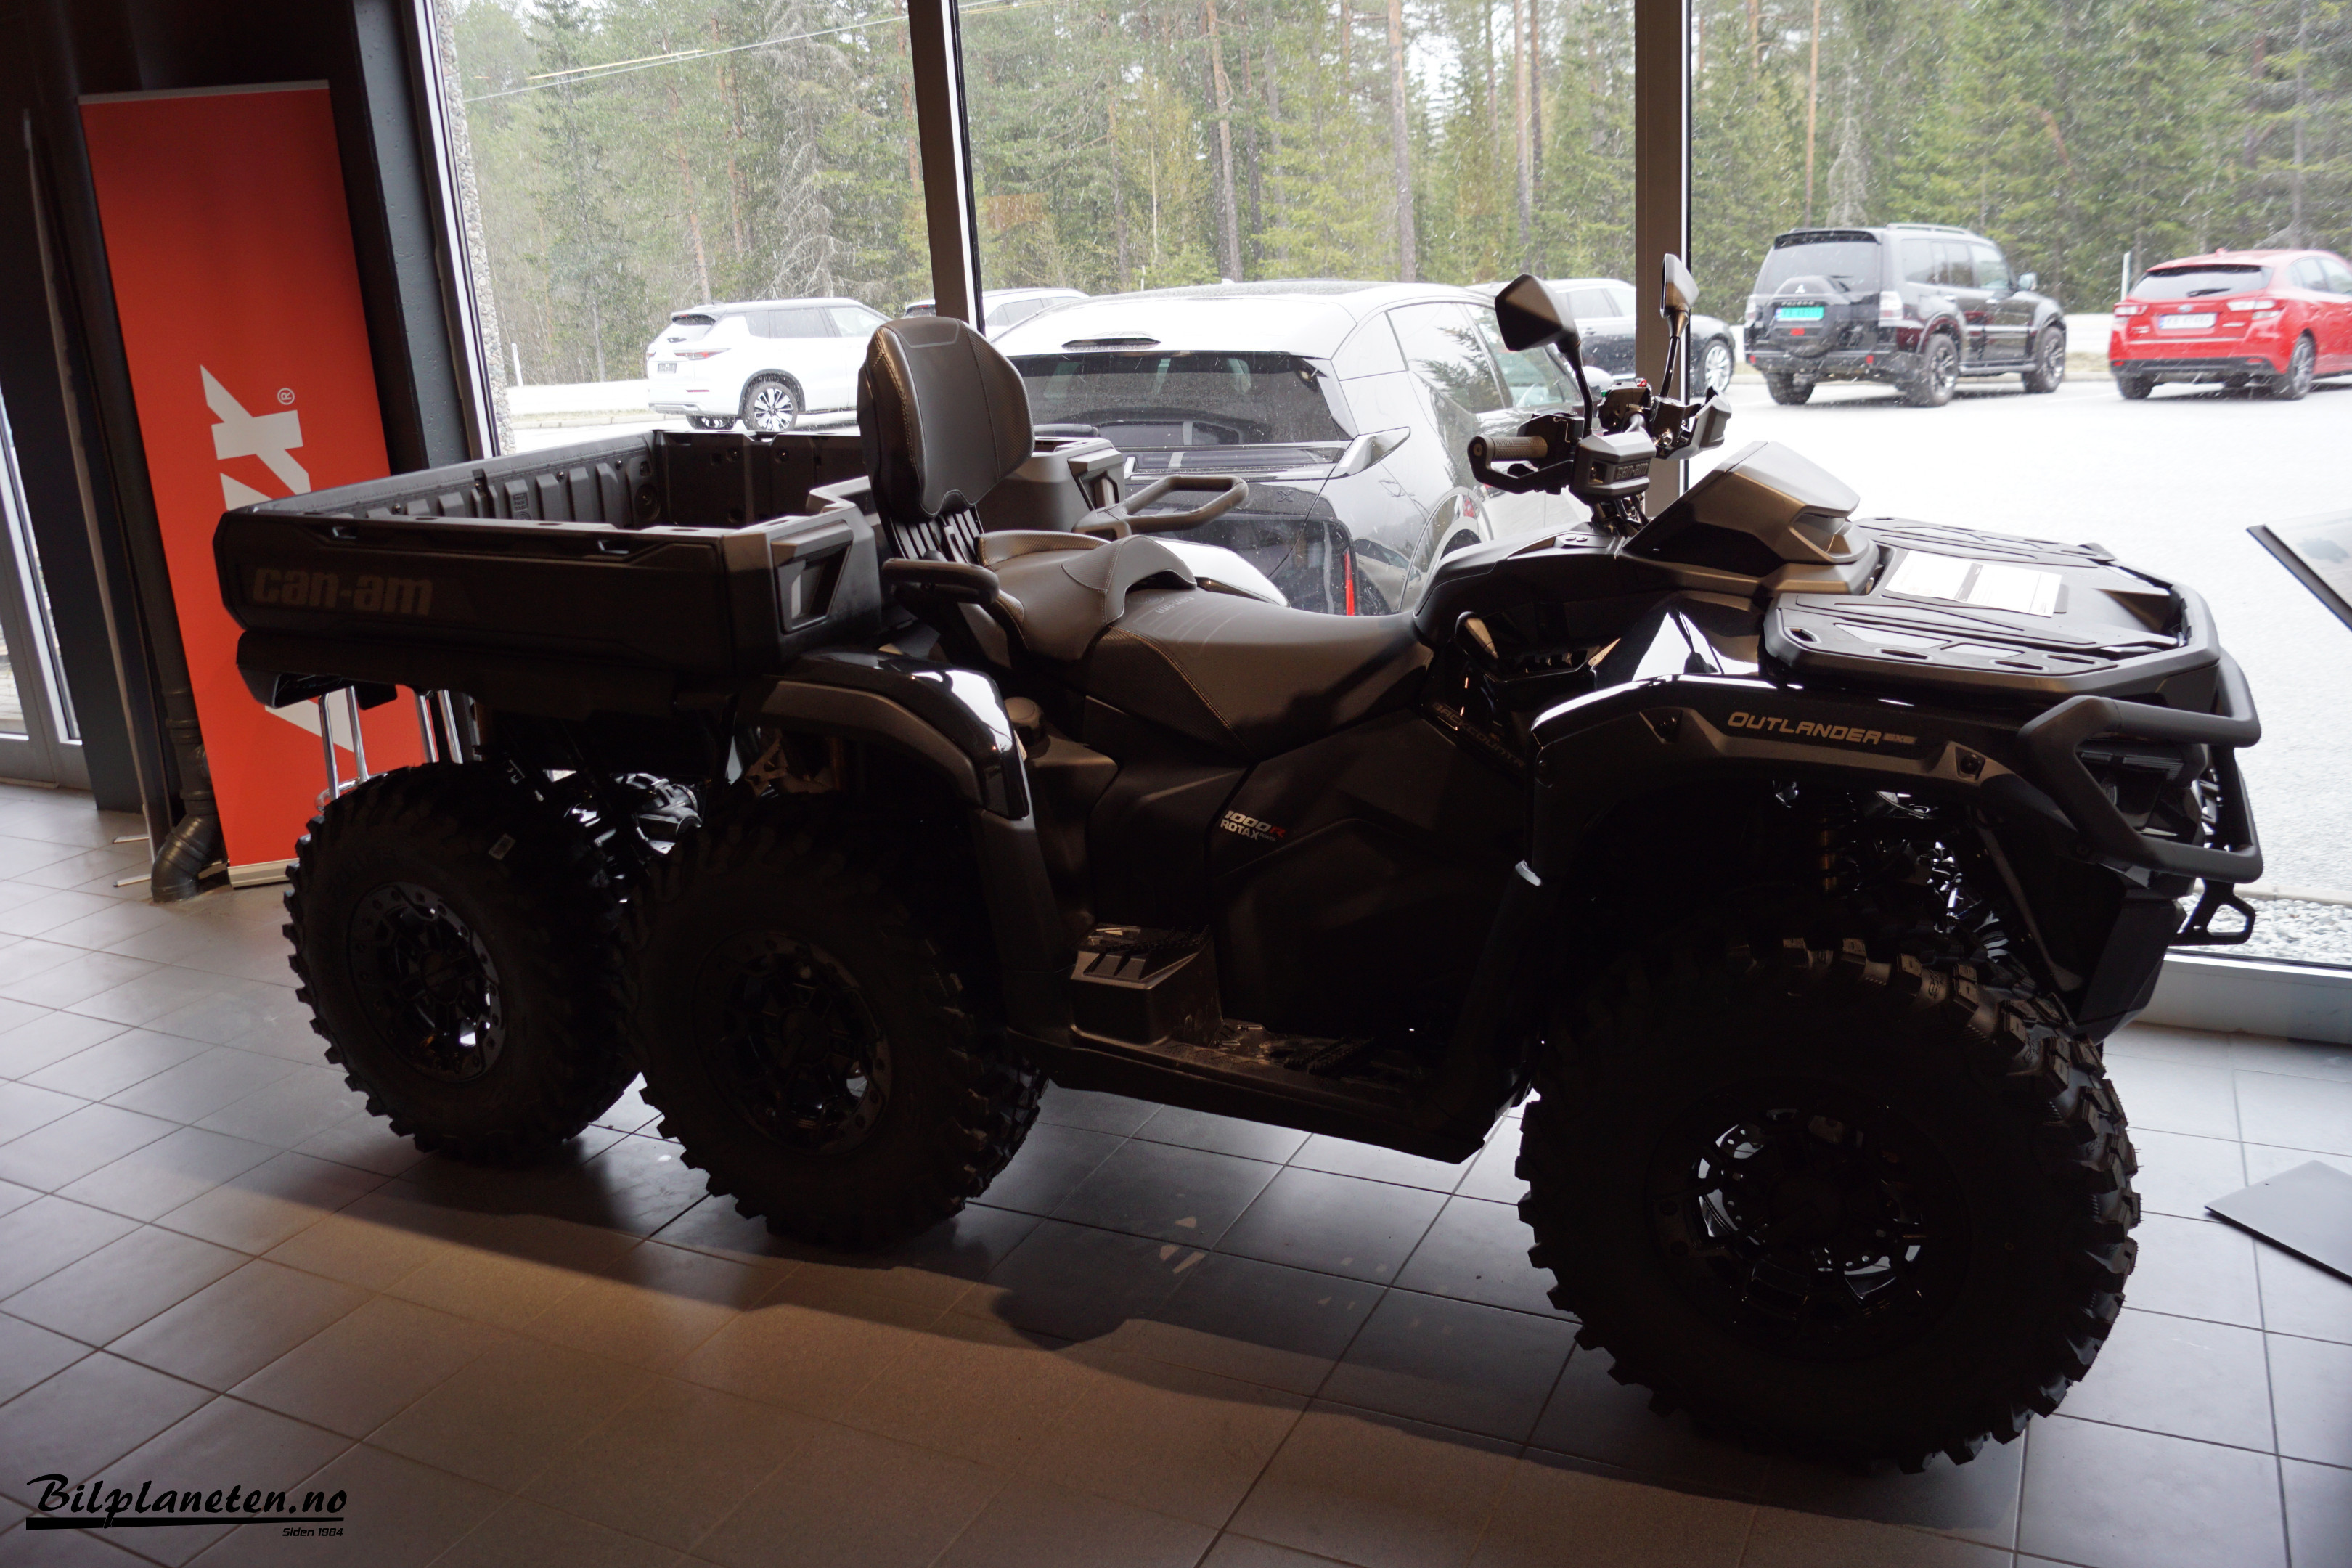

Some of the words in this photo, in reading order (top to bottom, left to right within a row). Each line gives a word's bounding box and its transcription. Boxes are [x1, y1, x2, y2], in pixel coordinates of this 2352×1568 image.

[253, 568, 433, 616] can-am
[1431, 701, 1527, 769] BACKCOUNTR
[1728, 711, 1882, 745] OUTLANDER
[1220, 818, 1260, 841] ROTAX
[1224, 809, 1286, 838] 1000R
